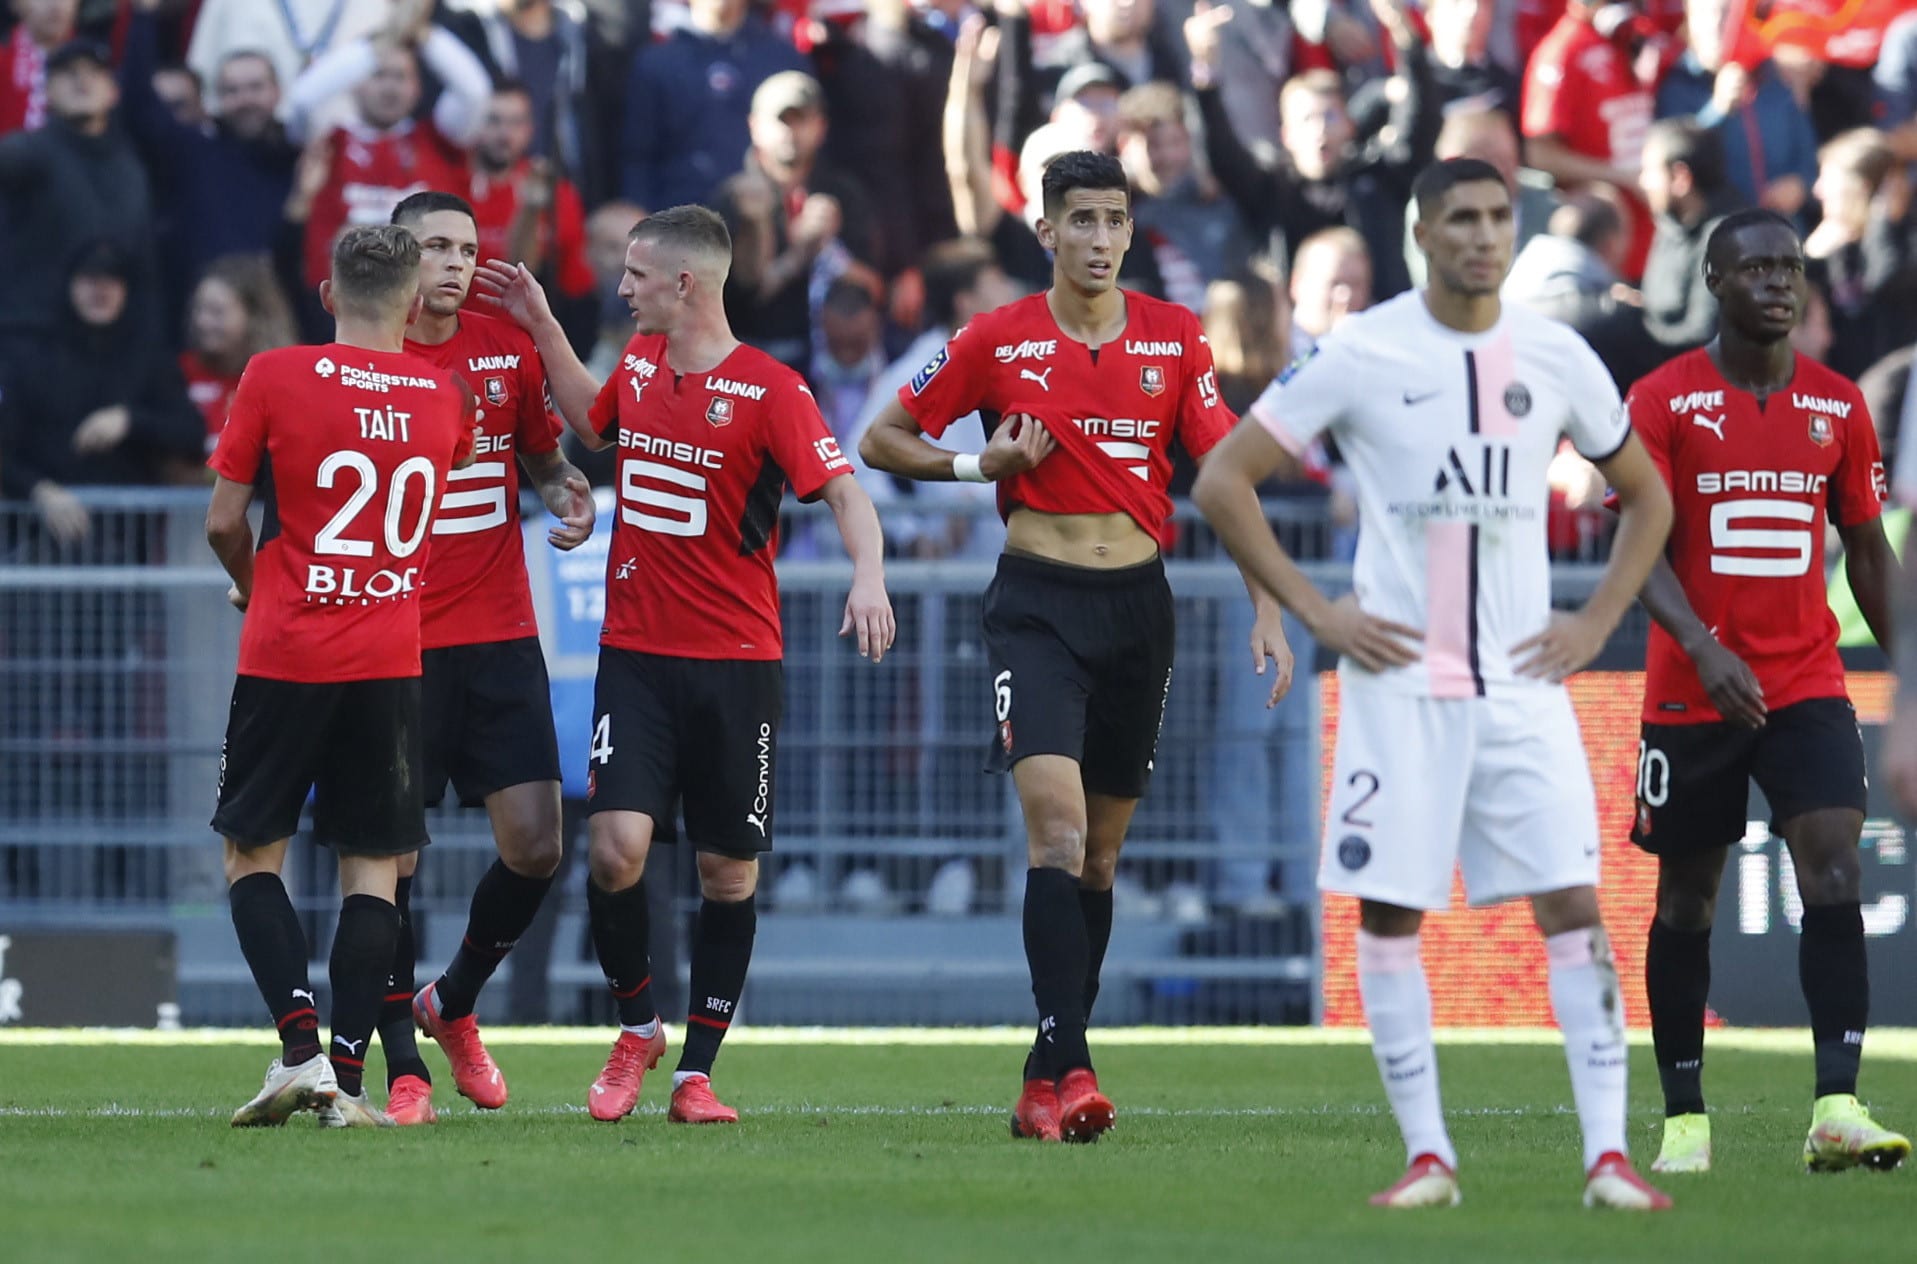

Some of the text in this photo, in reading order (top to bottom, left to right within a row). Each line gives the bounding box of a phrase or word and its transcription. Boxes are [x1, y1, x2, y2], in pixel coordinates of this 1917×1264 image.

[1125, 339, 1183, 357] LAUNAY
[468, 355, 520, 372] LAUNAY
[340, 364, 437, 390] POKERSTARS
[341, 376, 389, 393] SPORTS
[705, 375, 767, 401] LAUNAY
[1792, 393, 1851, 419] LAUNAY
[617, 427, 724, 470] SAMSIC
[314, 449, 436, 559] 20
[994, 669, 1013, 722] 6
[591, 712, 614, 765] 4
[753, 722, 771, 814] Convivio
[1341, 769, 1380, 829] 2
[706, 996, 732, 1014] SRFC
